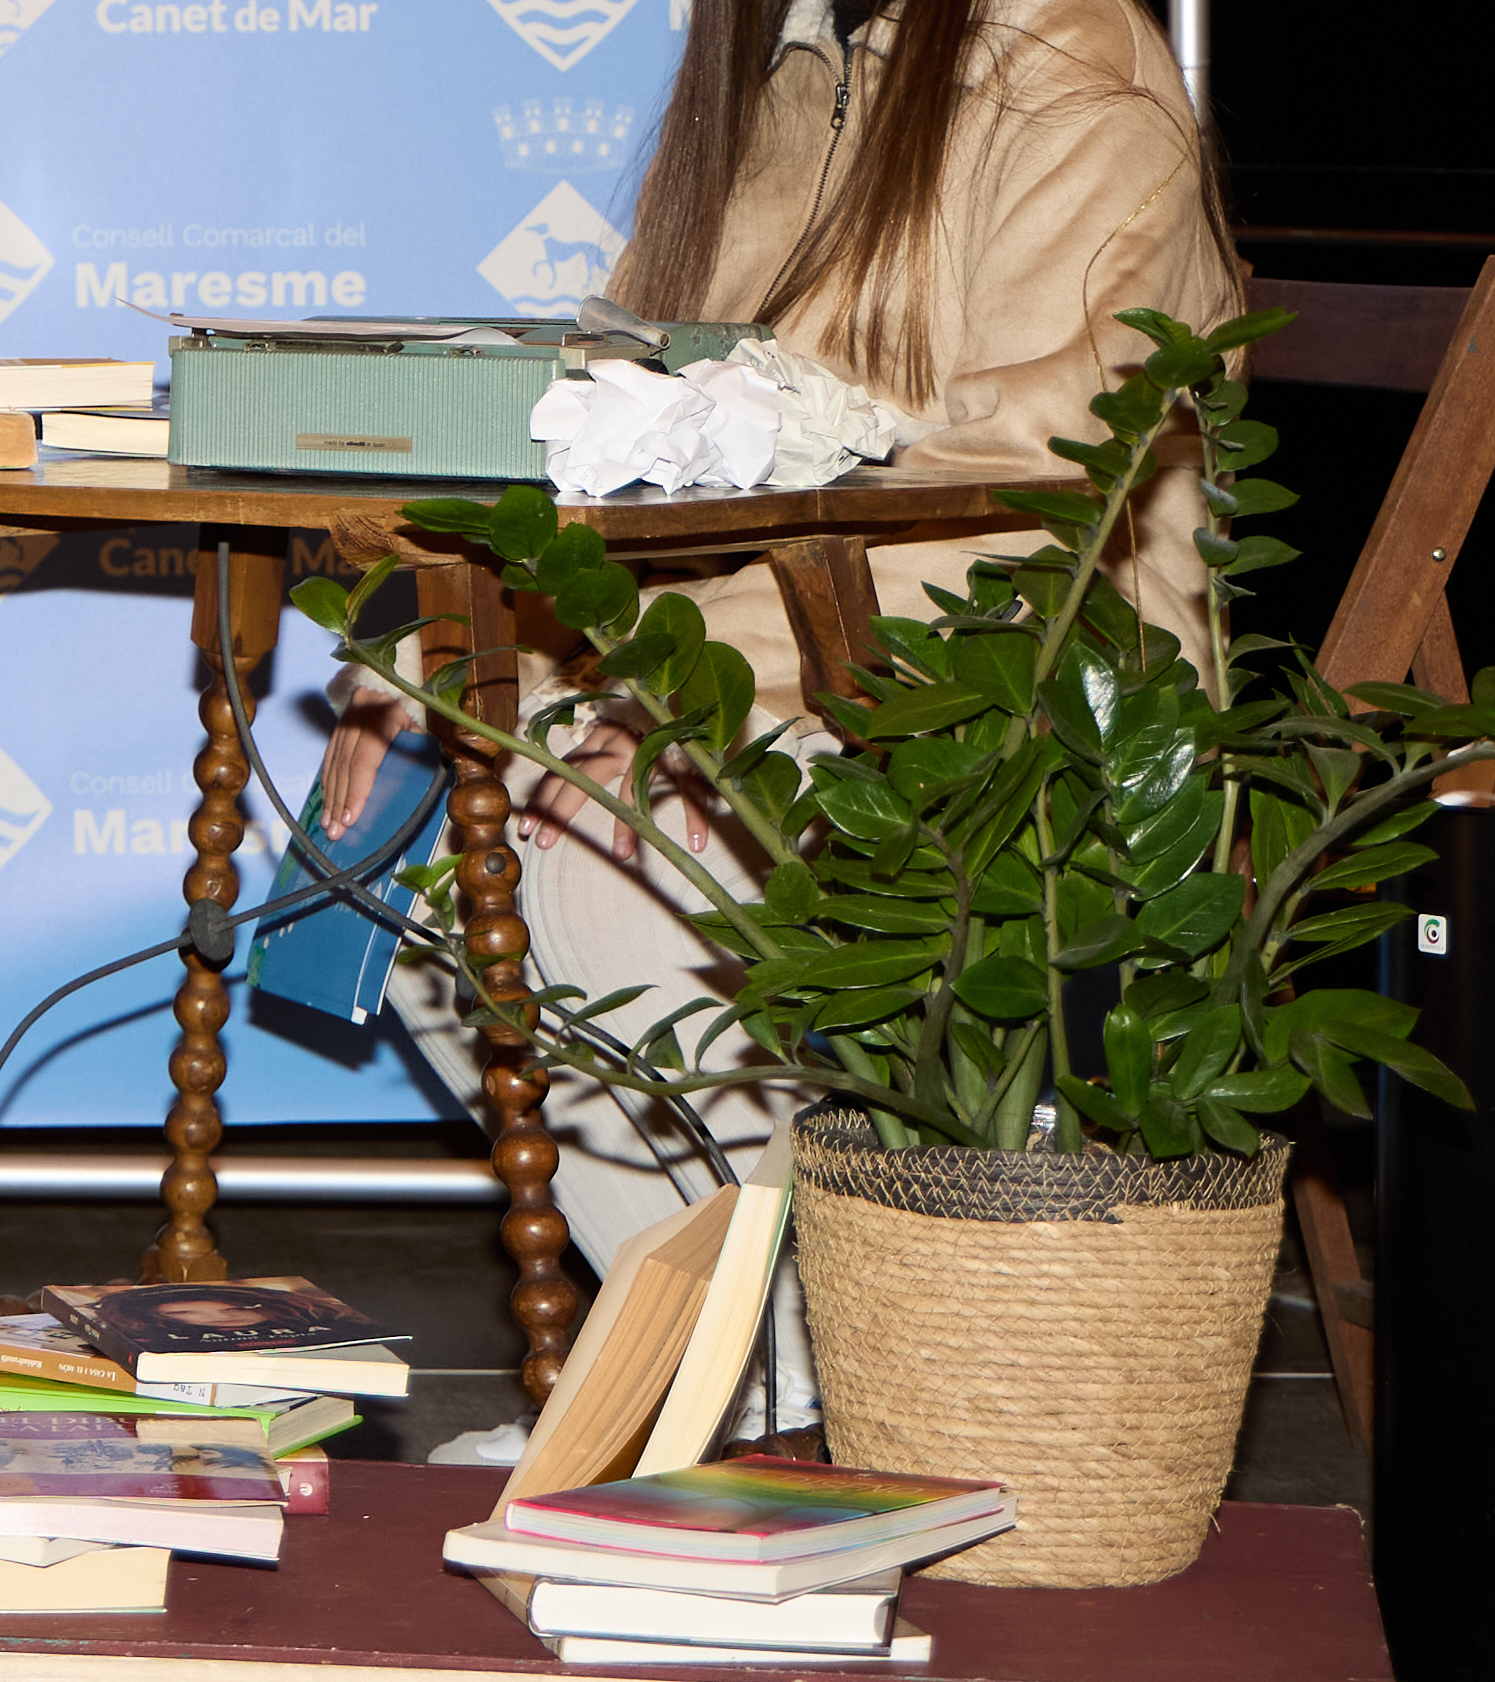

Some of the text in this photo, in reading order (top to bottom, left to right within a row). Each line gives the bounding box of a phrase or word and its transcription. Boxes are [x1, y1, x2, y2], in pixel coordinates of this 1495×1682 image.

[234, 0, 281, 33] de
[72, 222, 366, 248] Consell Comarcal del
[75, 261, 366, 309] Maresme
[99, 538, 198, 577] Cane
[167, 1323, 333, 1341] LAURA
